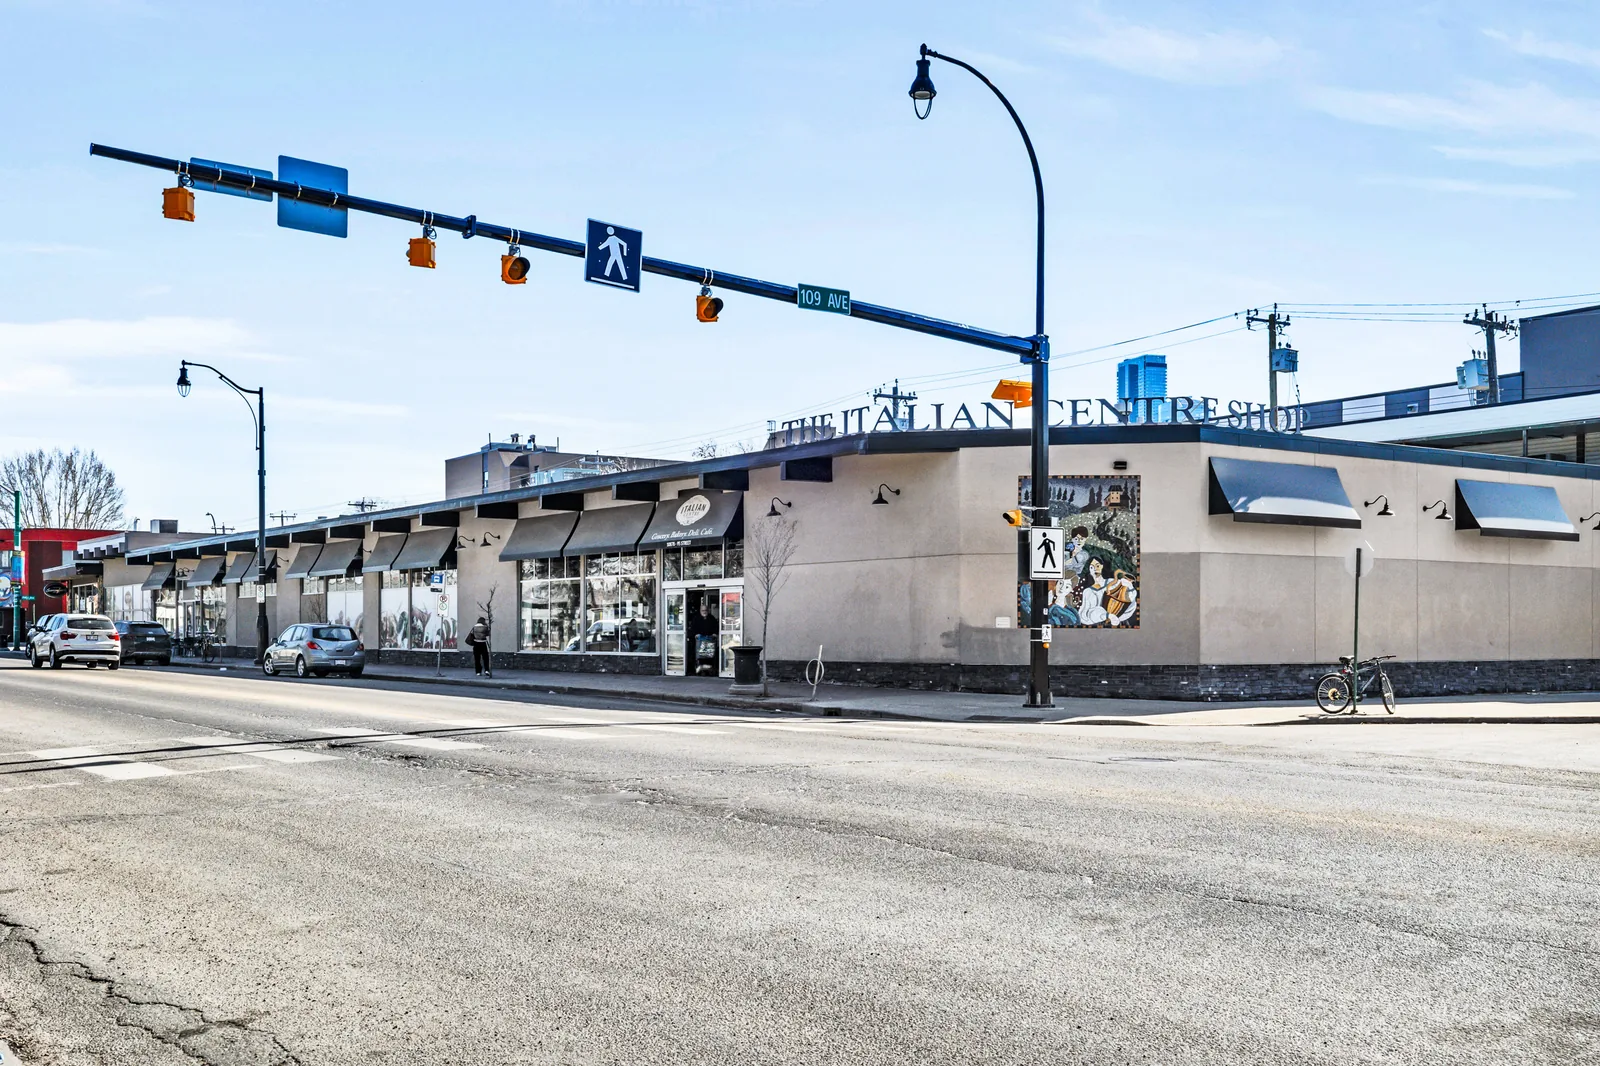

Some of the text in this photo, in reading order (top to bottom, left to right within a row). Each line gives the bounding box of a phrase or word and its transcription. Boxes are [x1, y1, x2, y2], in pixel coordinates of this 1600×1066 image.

[801, 289, 848, 310] 109 AVE
[782, 413, 834, 446] THE
[841, 402, 1015, 436] ITALIAN
[1228, 400, 1312, 435] SHOP
[681, 504, 706, 514] ITALIAN
